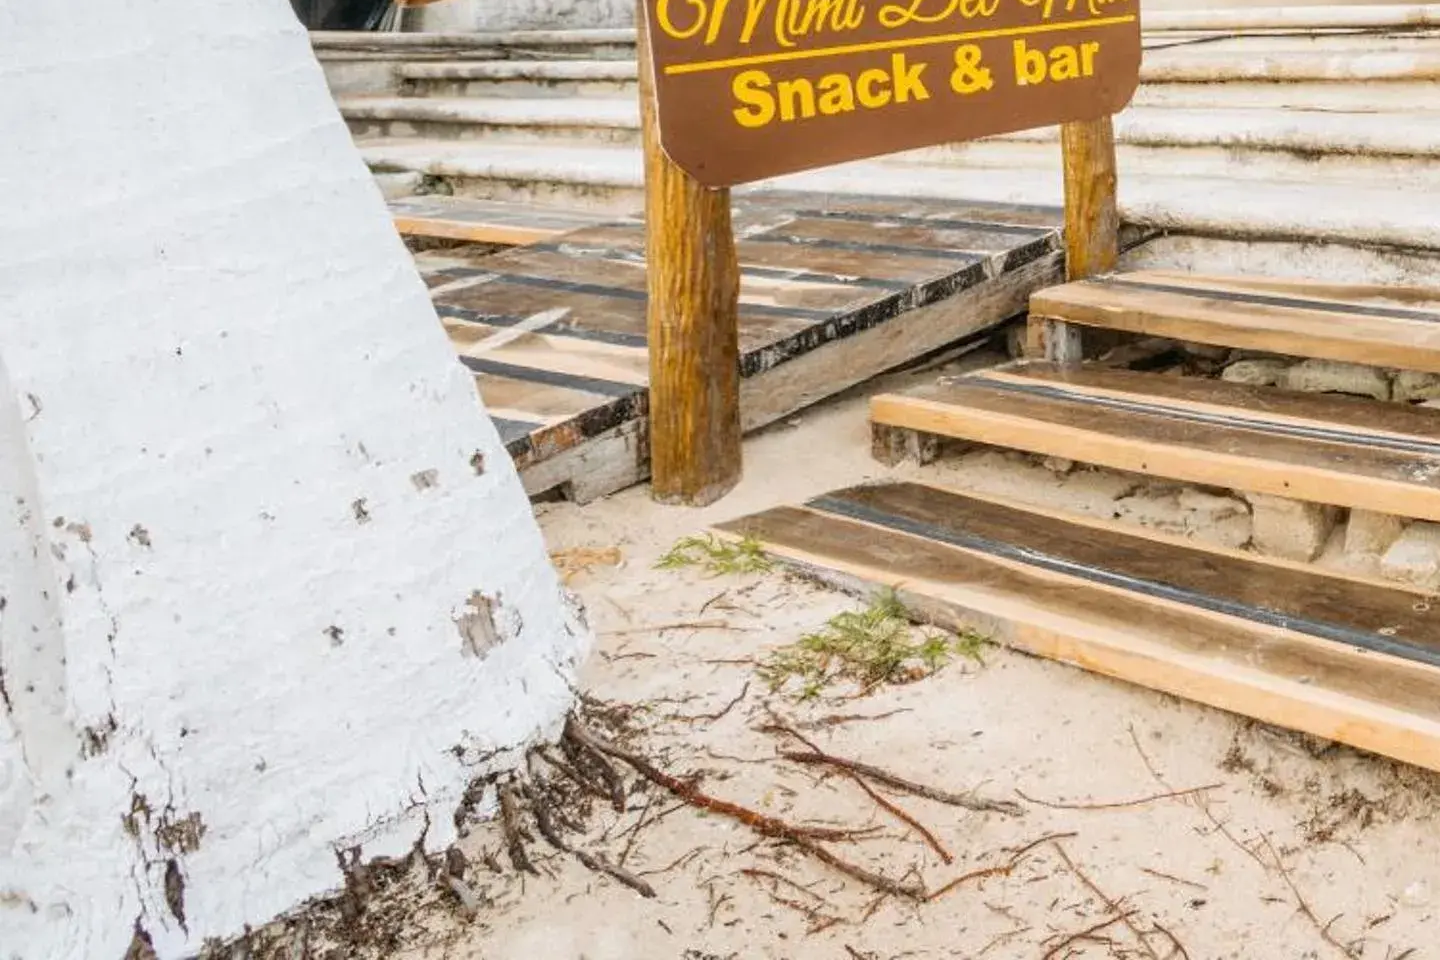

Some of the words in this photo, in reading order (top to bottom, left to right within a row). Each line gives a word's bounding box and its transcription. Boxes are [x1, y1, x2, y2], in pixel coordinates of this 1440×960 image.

[732, 53, 930, 128] Snack
[950, 43, 993, 95] &
[1013, 39, 1100, 86] bar
